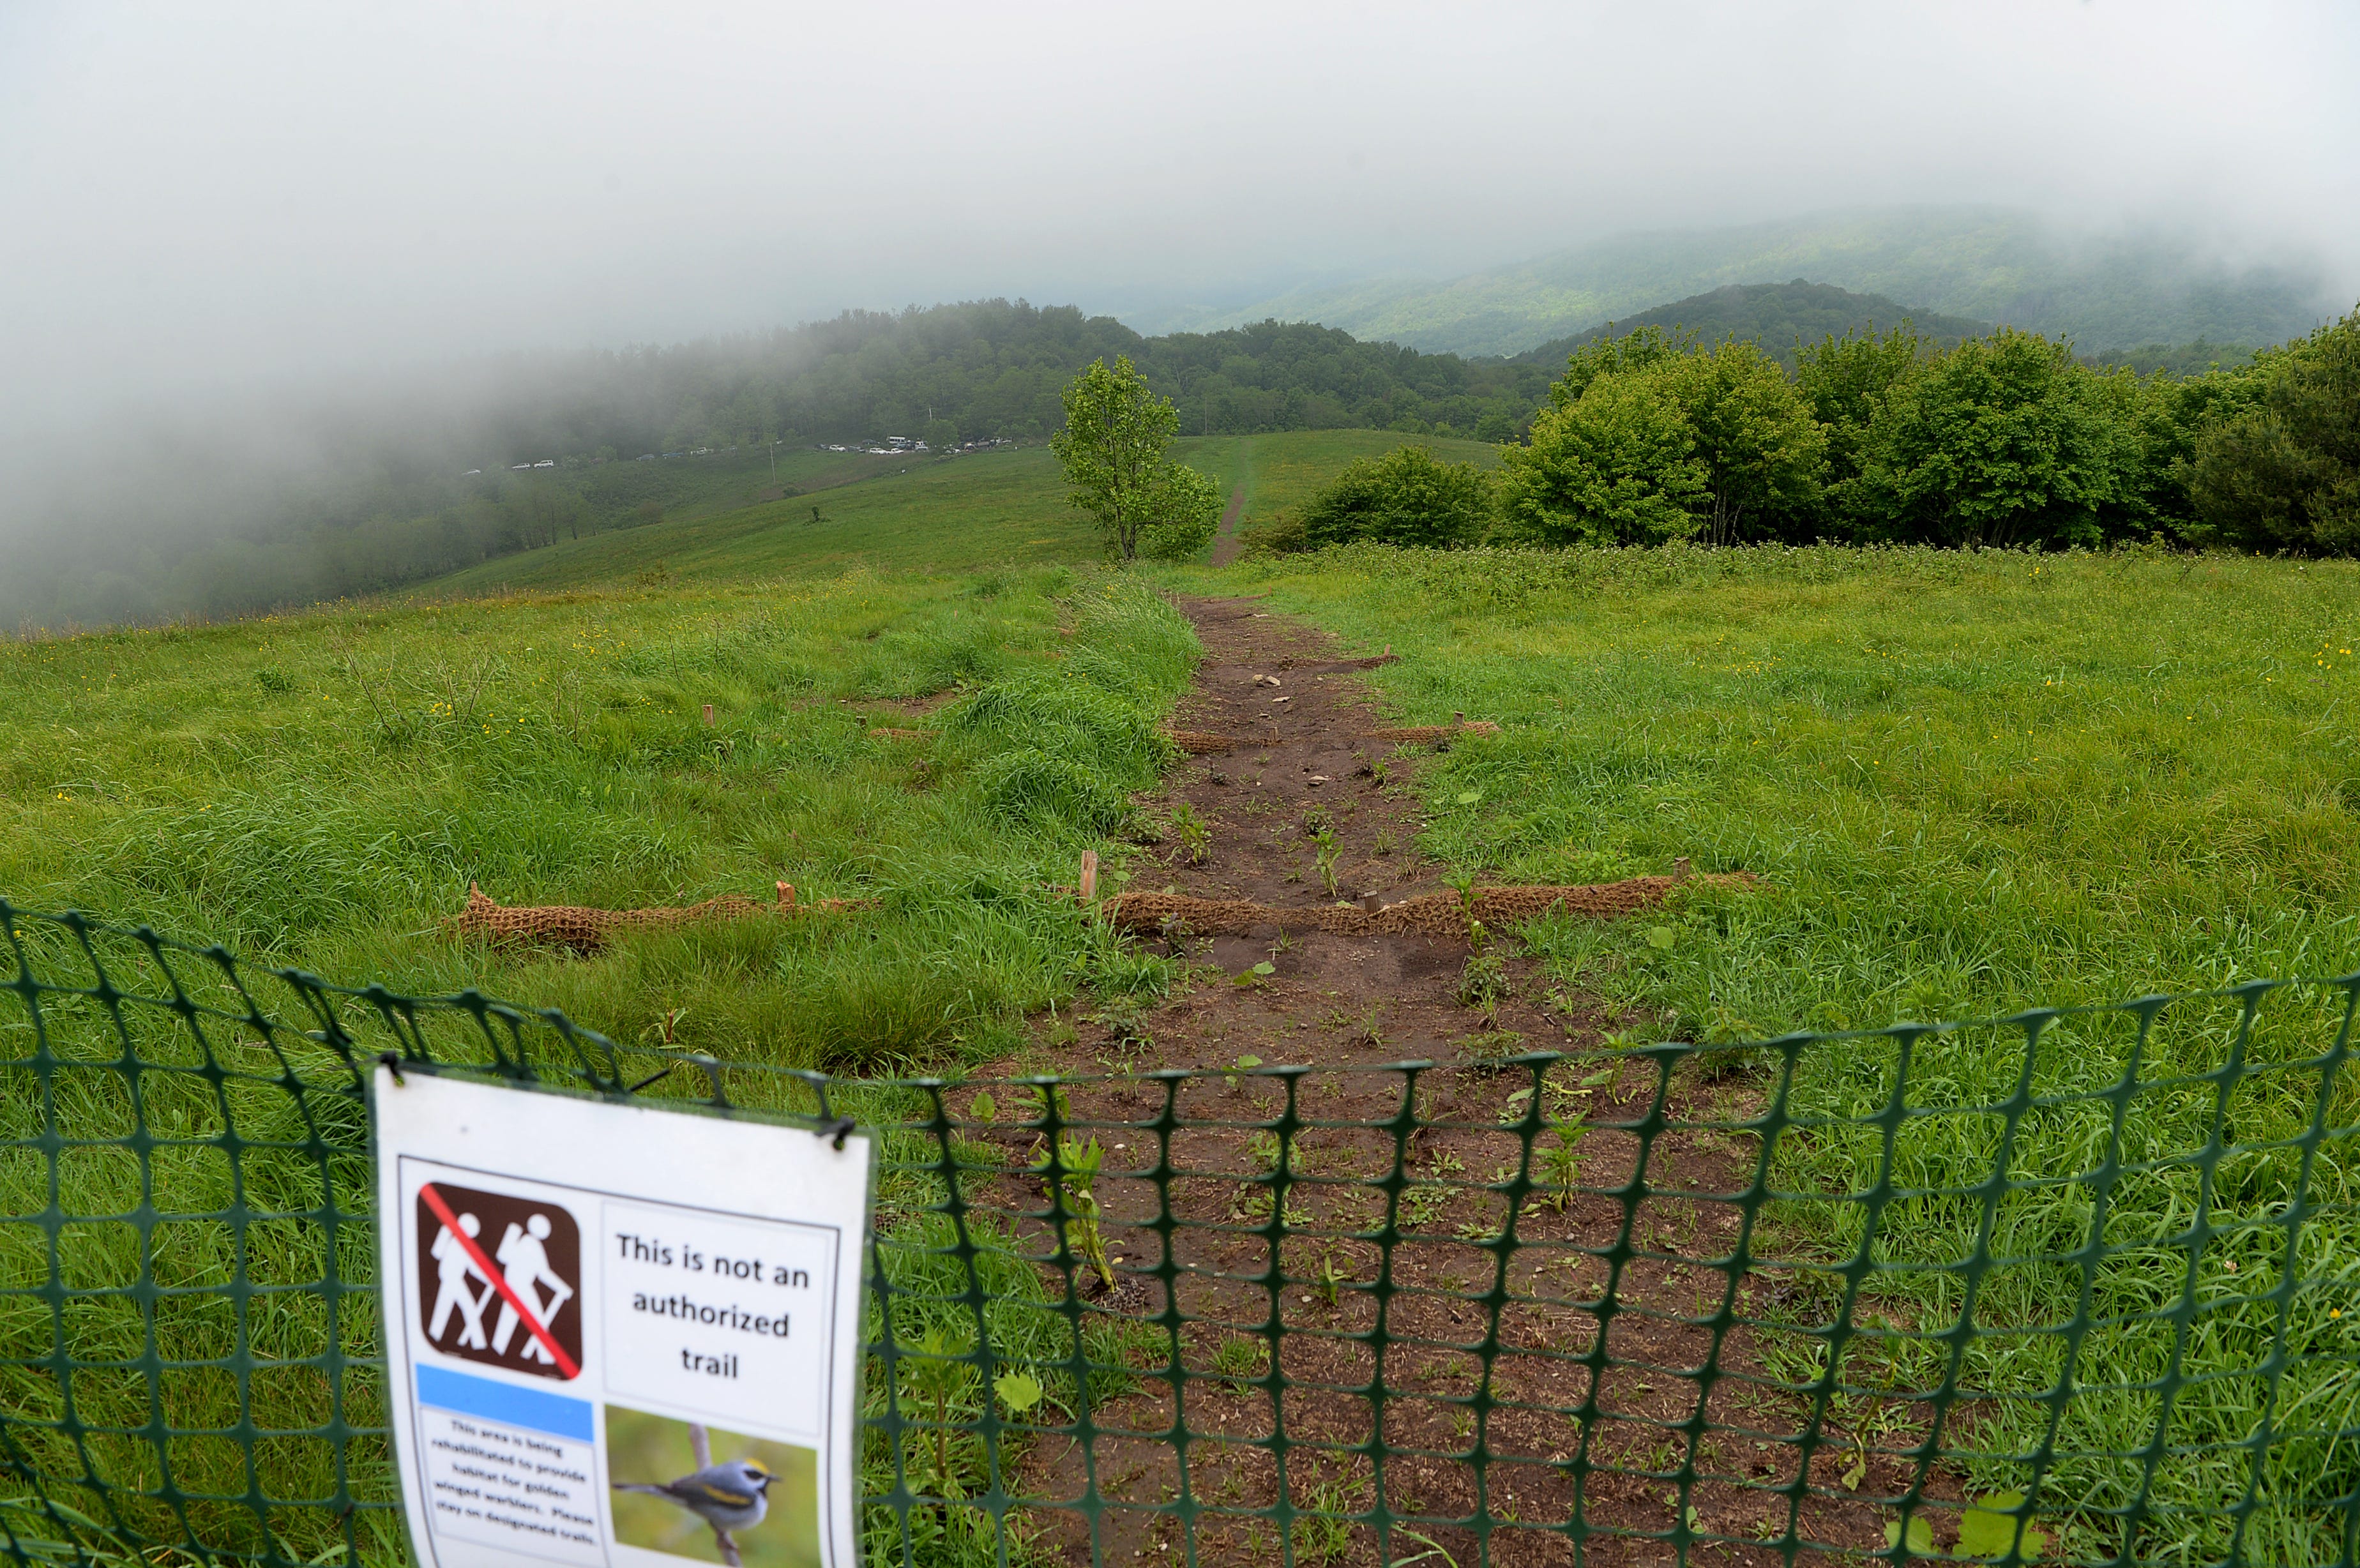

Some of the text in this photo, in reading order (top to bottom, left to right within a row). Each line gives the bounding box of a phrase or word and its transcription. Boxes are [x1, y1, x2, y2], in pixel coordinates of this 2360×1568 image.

[616, 1232, 810, 1290] This is not an
[633, 1292, 789, 1338] authorized
[681, 1347, 738, 1380] trail
[451, 1419, 563, 1459] This area is being
[432, 1438, 586, 1483] rehabilitated to provide
[452, 1461, 569, 1500] habitat for golden
[434, 1481, 480, 1498] winged
[551, 1506, 594, 1526] Please
[435, 1500, 461, 1514] stay
[465, 1508, 481, 1518] on
